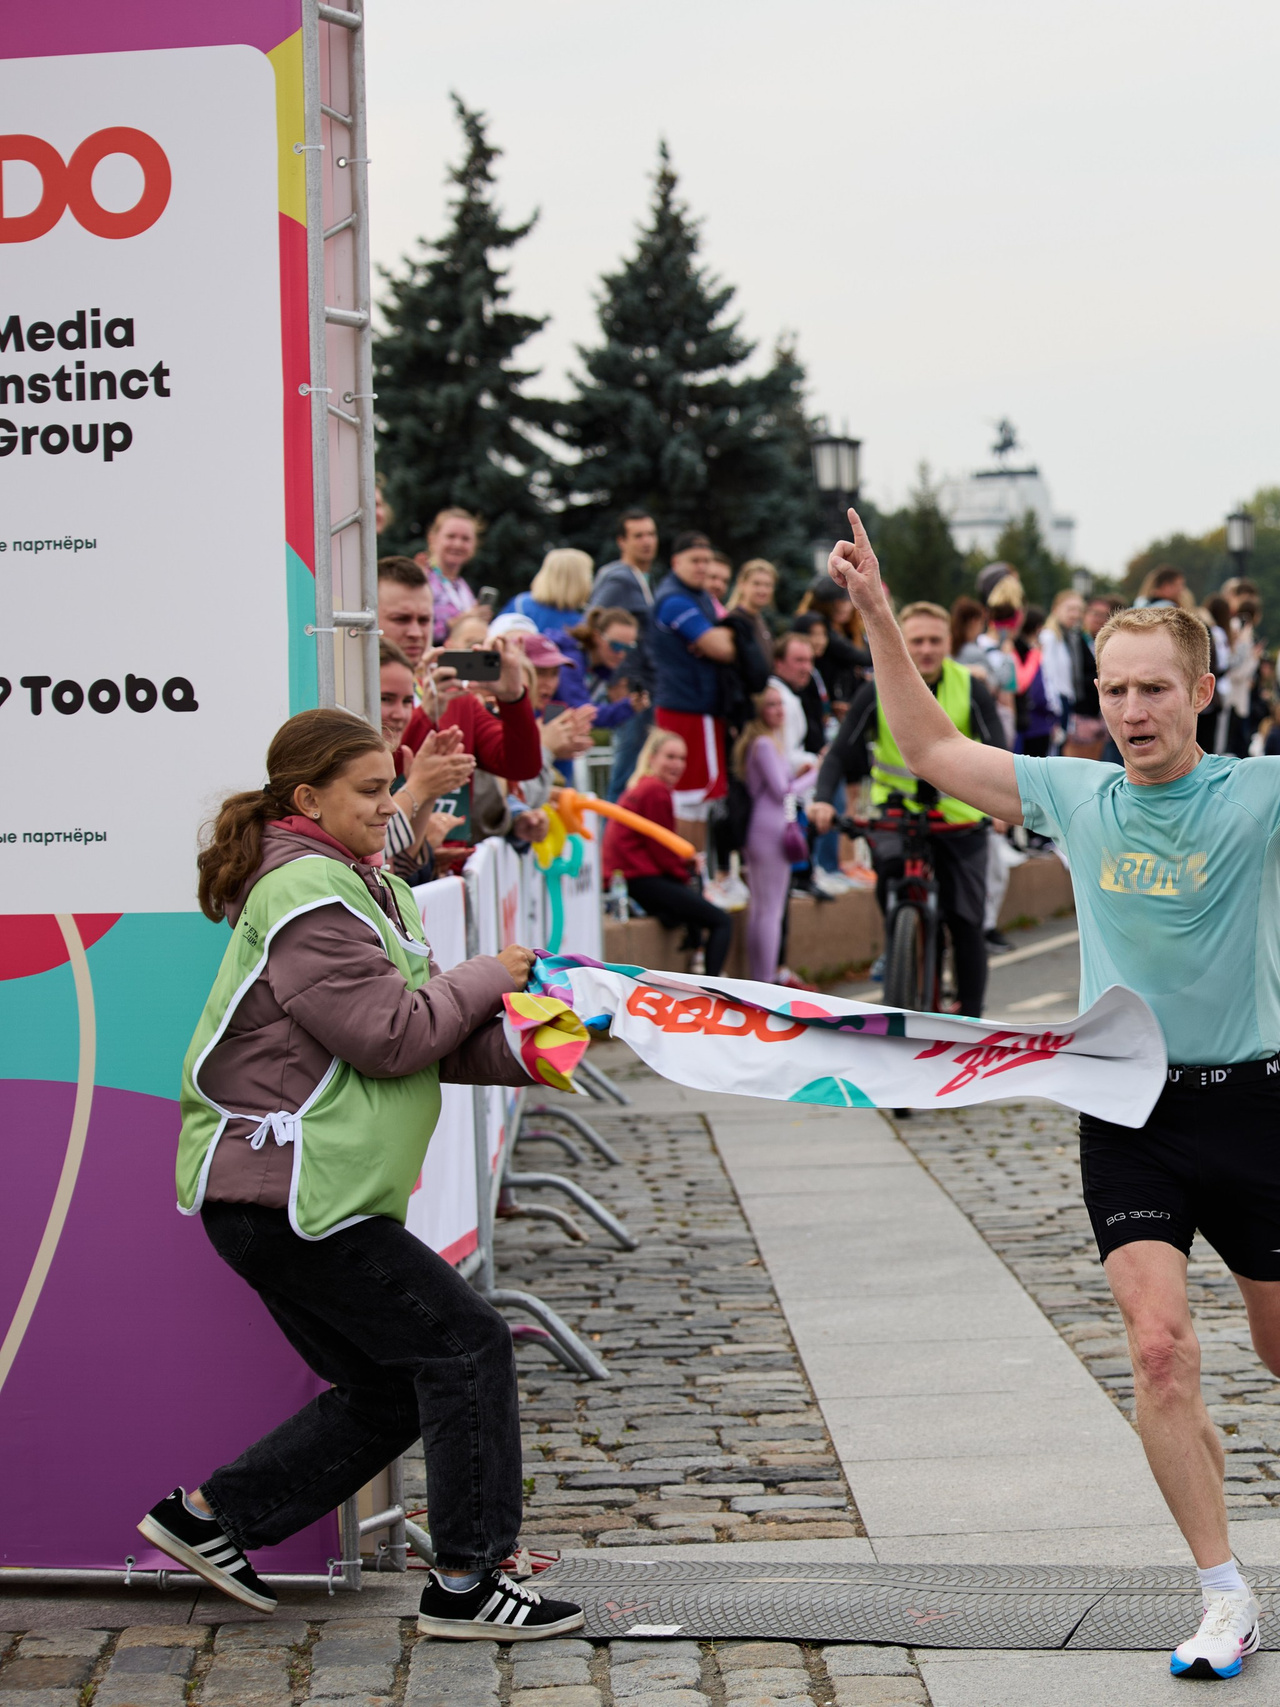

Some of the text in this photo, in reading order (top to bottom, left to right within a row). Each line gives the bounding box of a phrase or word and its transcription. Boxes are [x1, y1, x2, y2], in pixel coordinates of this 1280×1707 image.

[0, 126, 172, 244] DO
[13, 535, 97, 554] партнёры
[20, 673, 199, 716] Tooba
[23, 828, 107, 846] партнёры
[1106, 1212, 1126, 1227] BG
